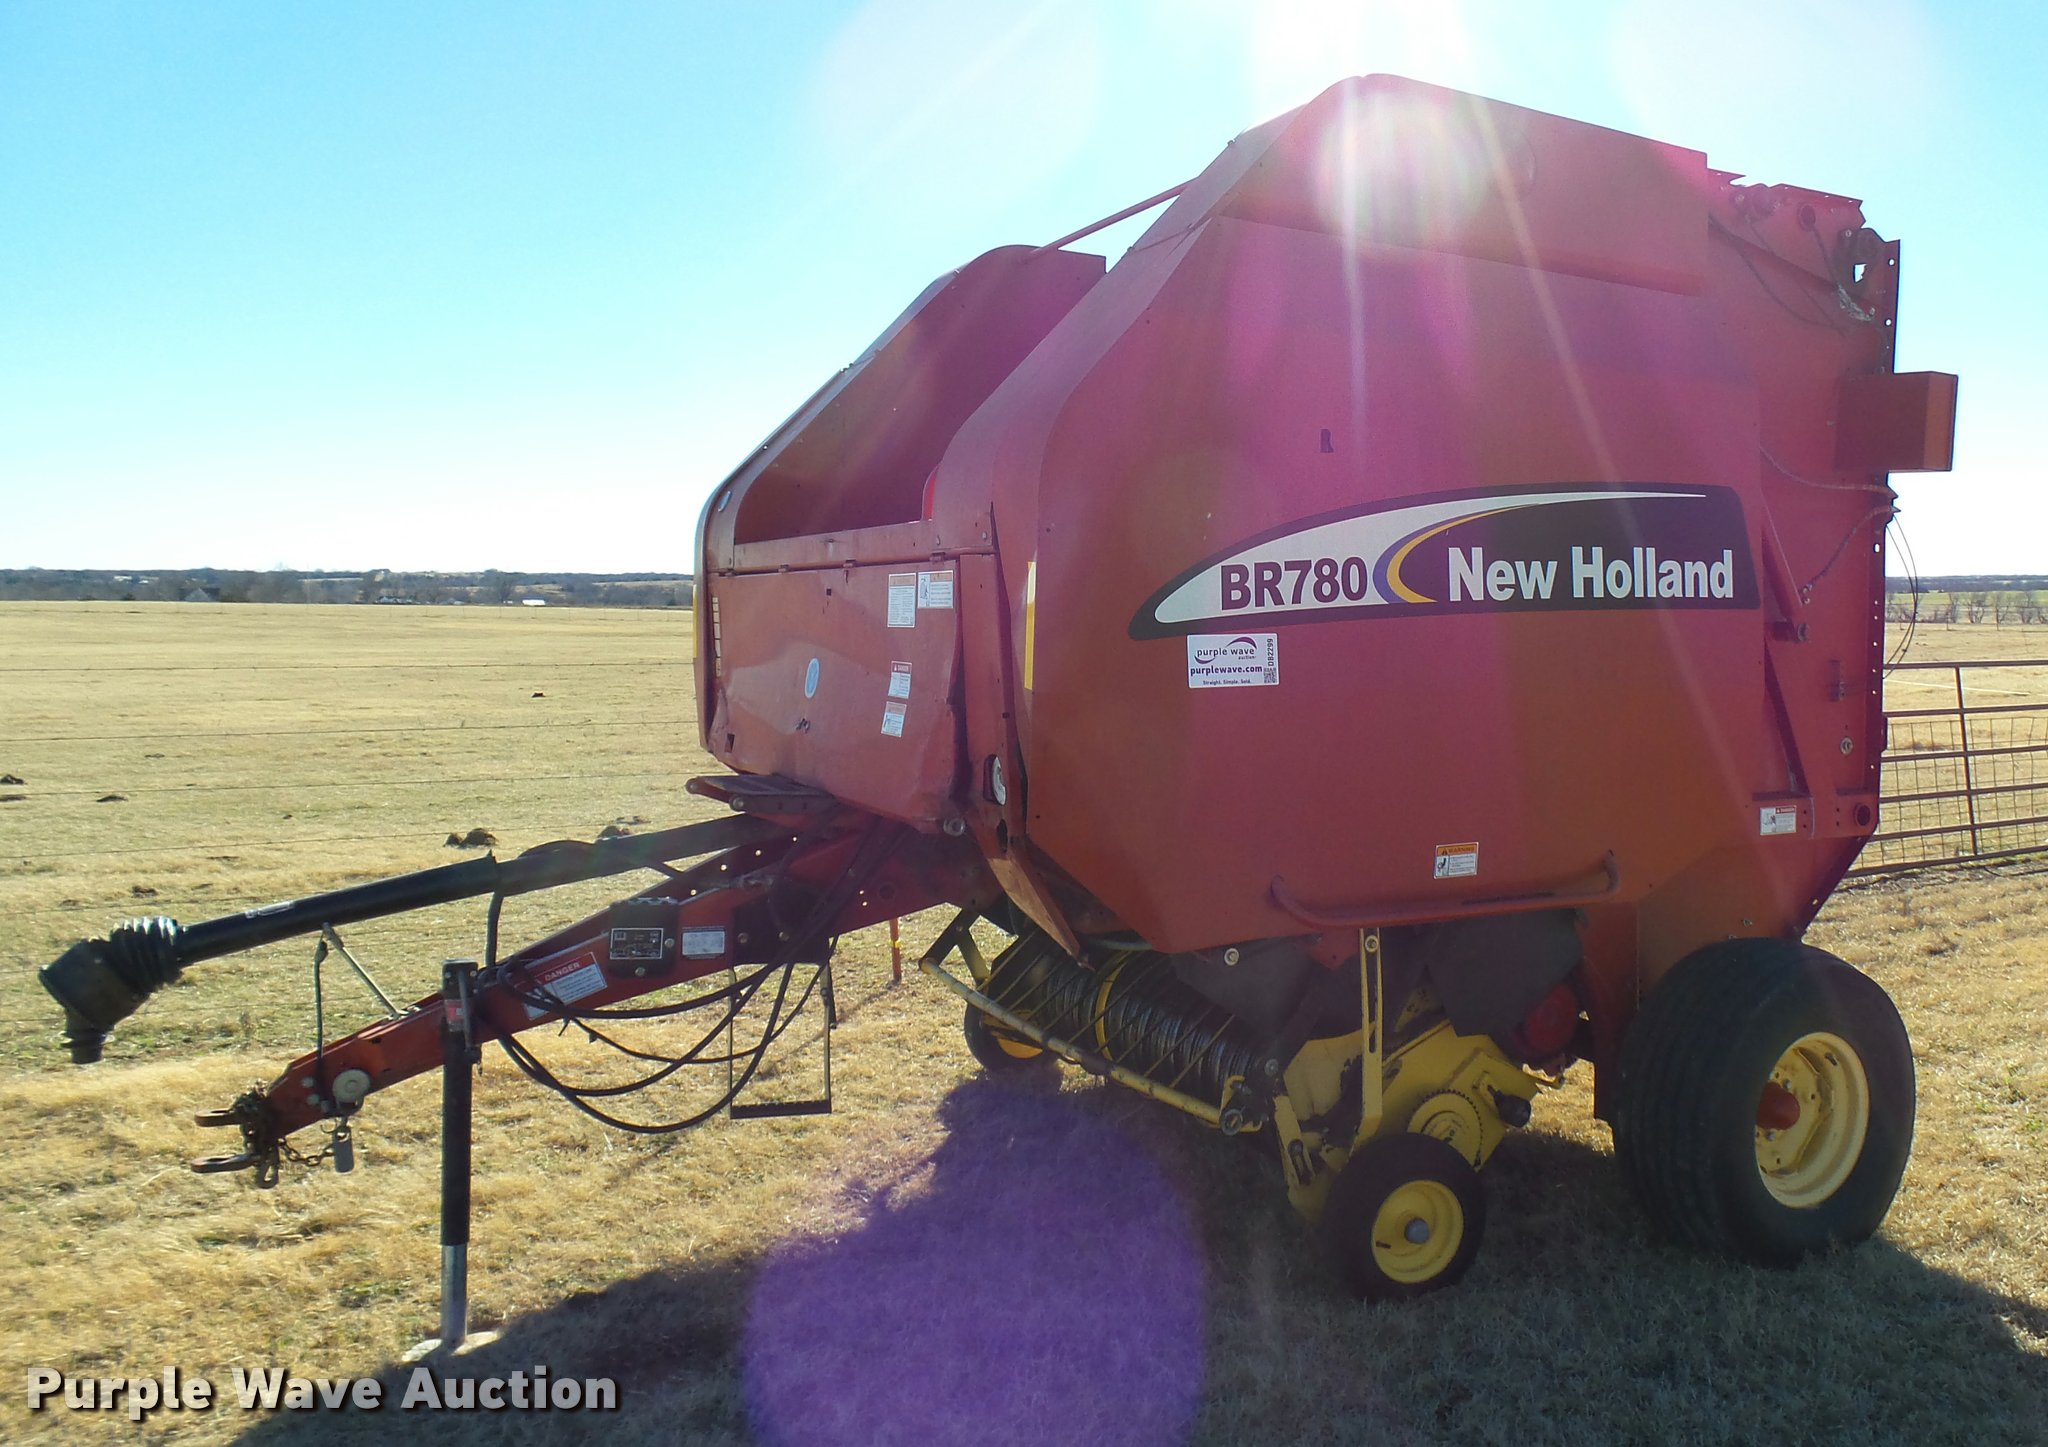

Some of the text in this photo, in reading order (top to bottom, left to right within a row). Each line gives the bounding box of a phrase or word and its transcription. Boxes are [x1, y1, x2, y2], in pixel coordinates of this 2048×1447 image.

[1220, 556, 1368, 611] BR780
[1448, 546, 1734, 602] New Holland
[1197, 647, 1255, 658] purple wave
[1190, 664, 1263, 677] purplewave.com
[544, 962, 581, 981] DANGER
